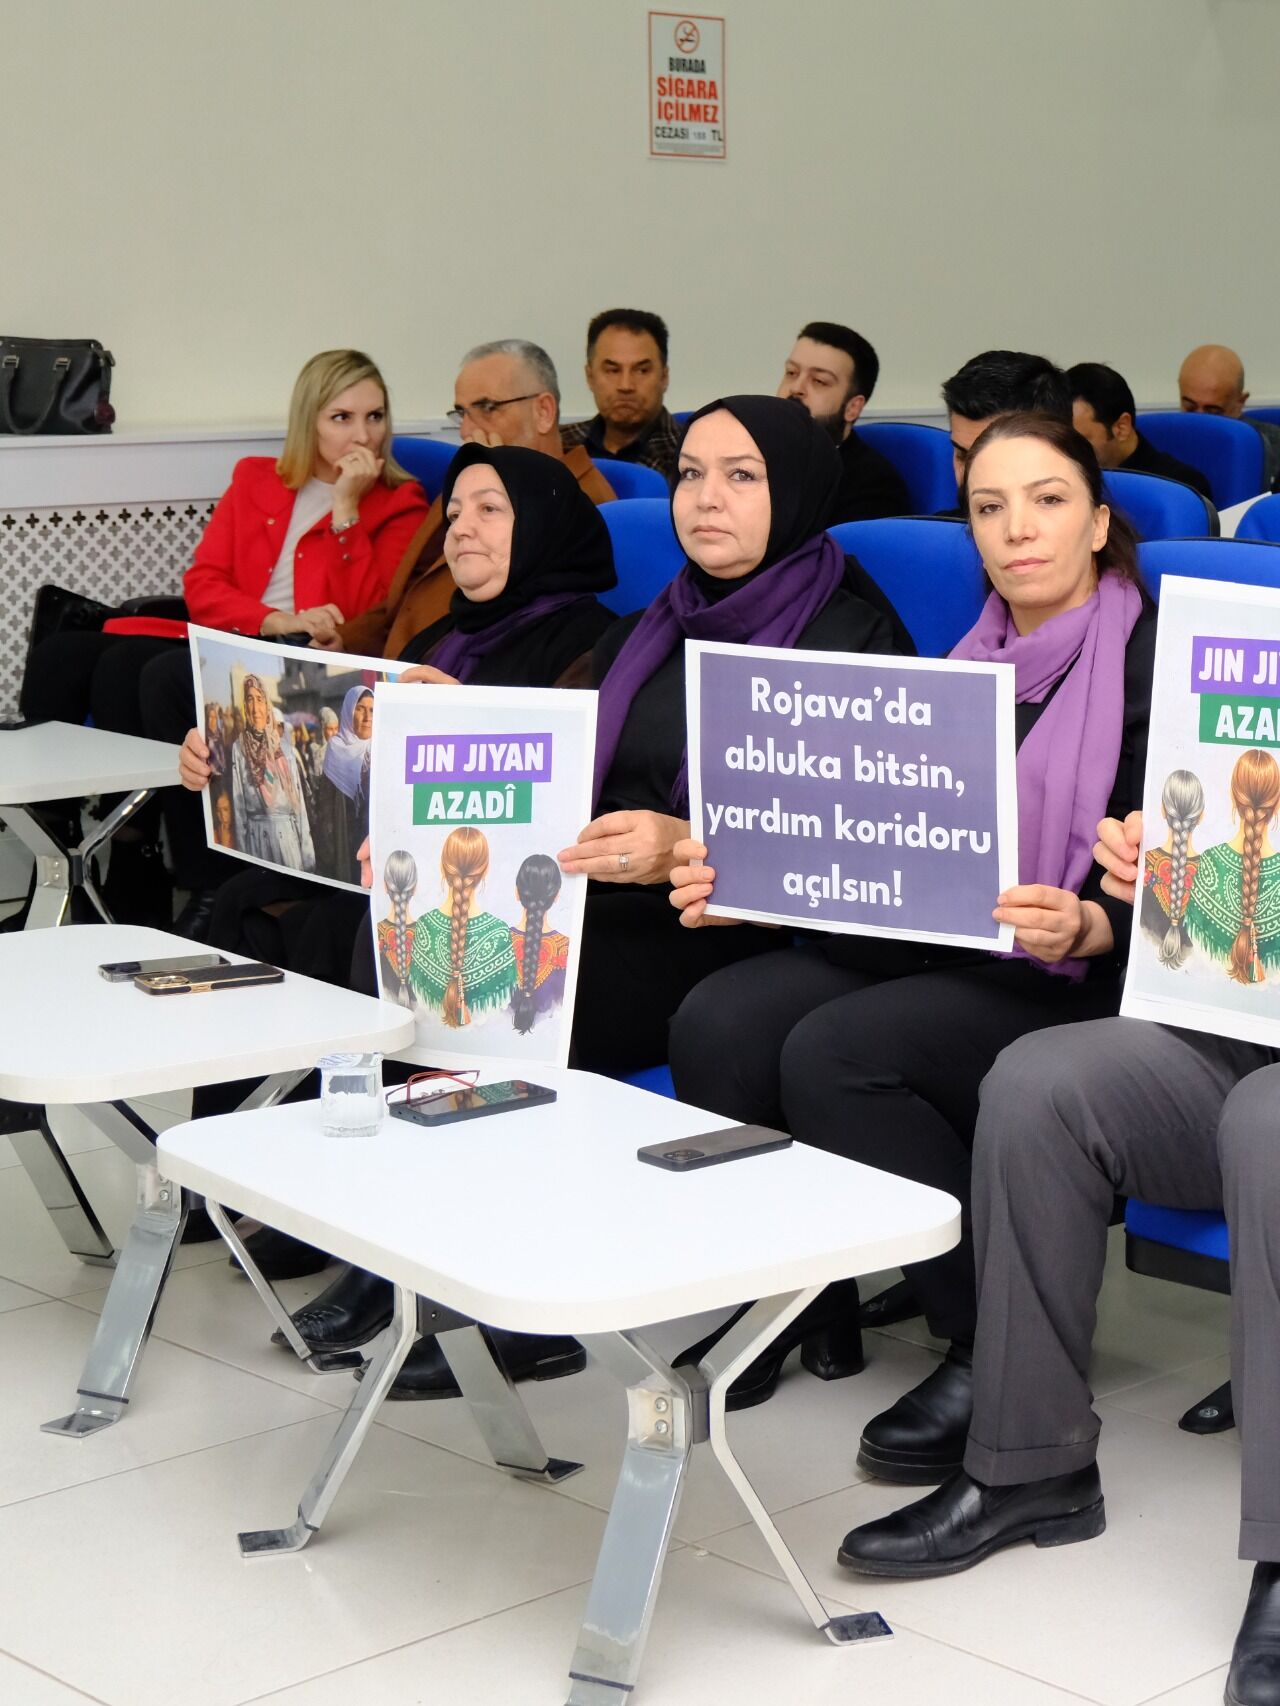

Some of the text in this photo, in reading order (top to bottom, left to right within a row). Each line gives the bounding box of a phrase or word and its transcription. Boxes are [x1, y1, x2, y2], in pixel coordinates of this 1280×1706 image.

[668, 57, 706, 74] BURADA
[656, 75, 718, 100] SİGARA
[657, 98, 719, 124] İÇİLMEZ
[655, 126, 689, 140] CEZASI
[711, 129, 723, 141] TL
[1198, 647, 1244, 683] JIN
[751, 676, 932, 727] Rojava’da
[412, 742, 544, 773] JIN JIYAN
[725, 735, 965, 798] abluka bitsin,
[427, 783, 517, 820] AZADÎ
[705, 797, 992, 854] yardım koridoru
[783, 863, 903, 908] açılsın!
